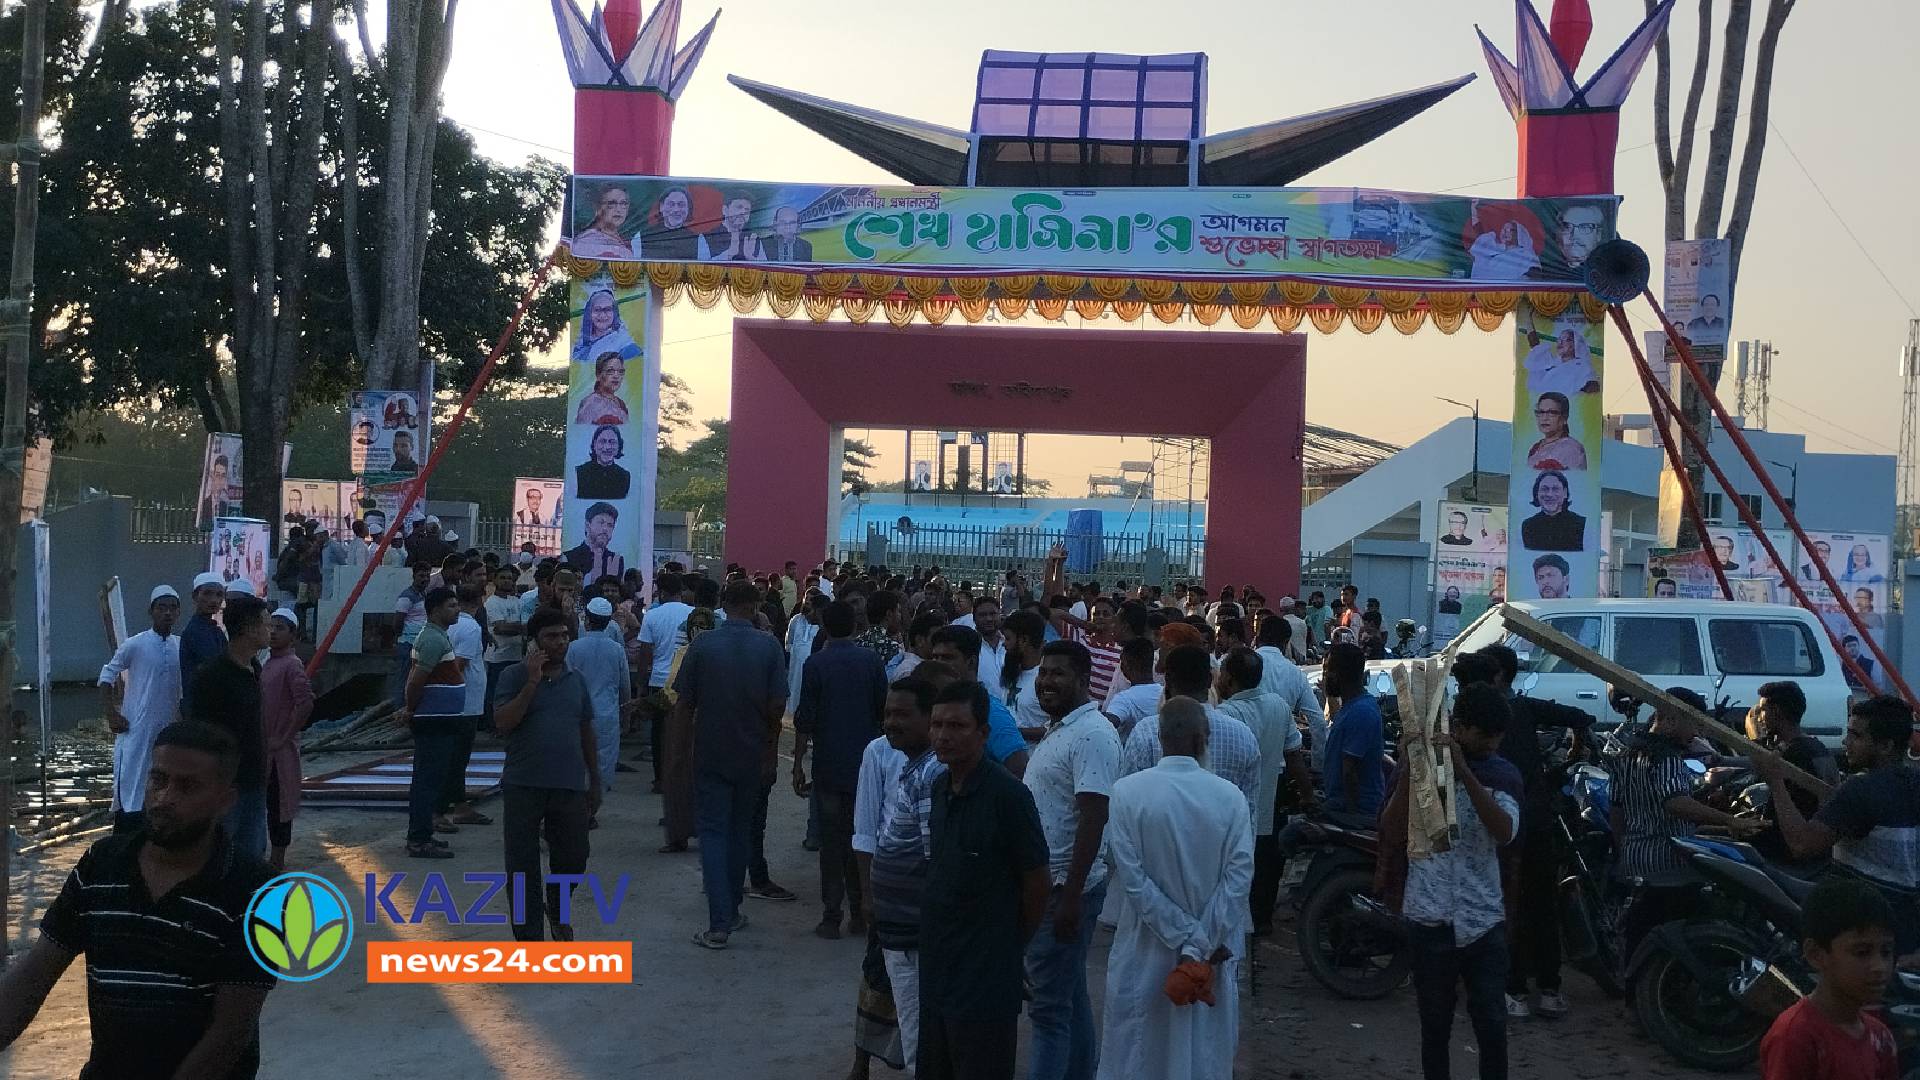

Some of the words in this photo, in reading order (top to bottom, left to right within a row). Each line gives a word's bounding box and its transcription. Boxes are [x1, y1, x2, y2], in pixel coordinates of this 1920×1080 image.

[843, 211, 951, 260] শেখ
[1200, 214, 1290, 233] আগমন
[1199, 235, 1290, 267] শুভেচ্ছা
